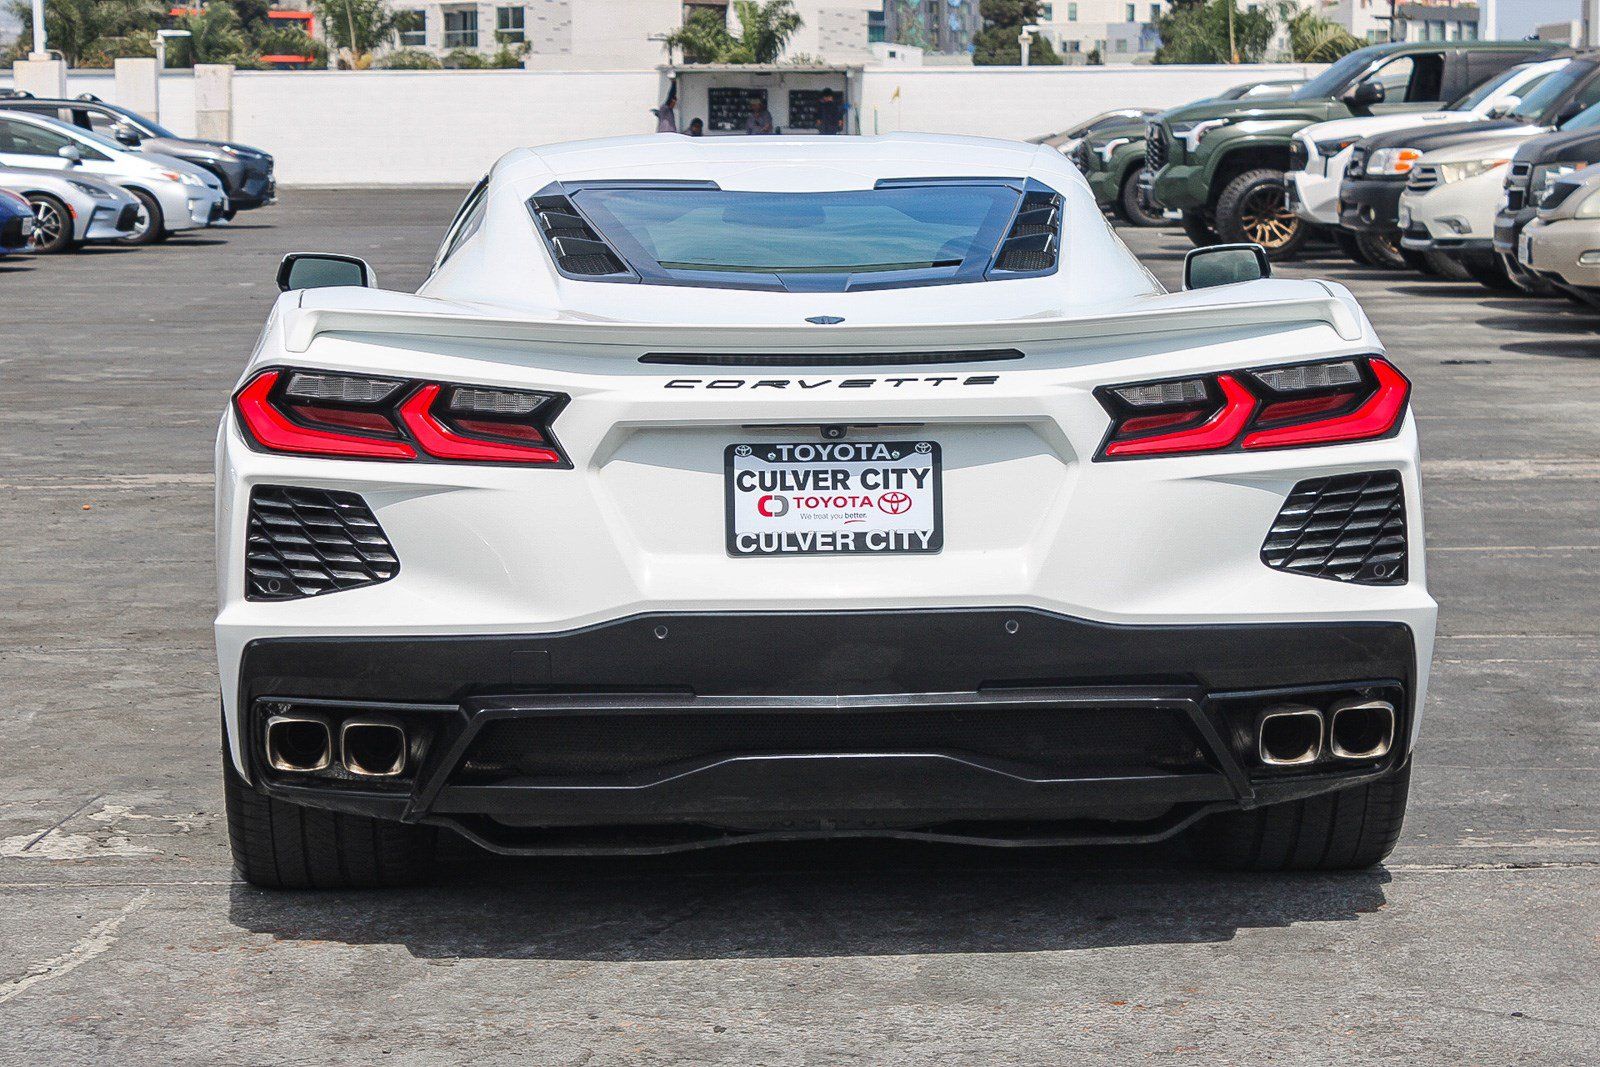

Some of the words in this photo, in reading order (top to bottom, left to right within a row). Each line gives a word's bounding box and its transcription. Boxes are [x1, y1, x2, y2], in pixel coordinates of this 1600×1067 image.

[664, 375, 999, 389] CORVETTE
[776, 444, 892, 461] TOYOTA
[736, 468, 850, 492] CULVER
[860, 468, 930, 490] CITY
[793, 495, 874, 509] TOYOTA
[735, 530, 855, 553] CULVER
[865, 529, 934, 551] CITY
